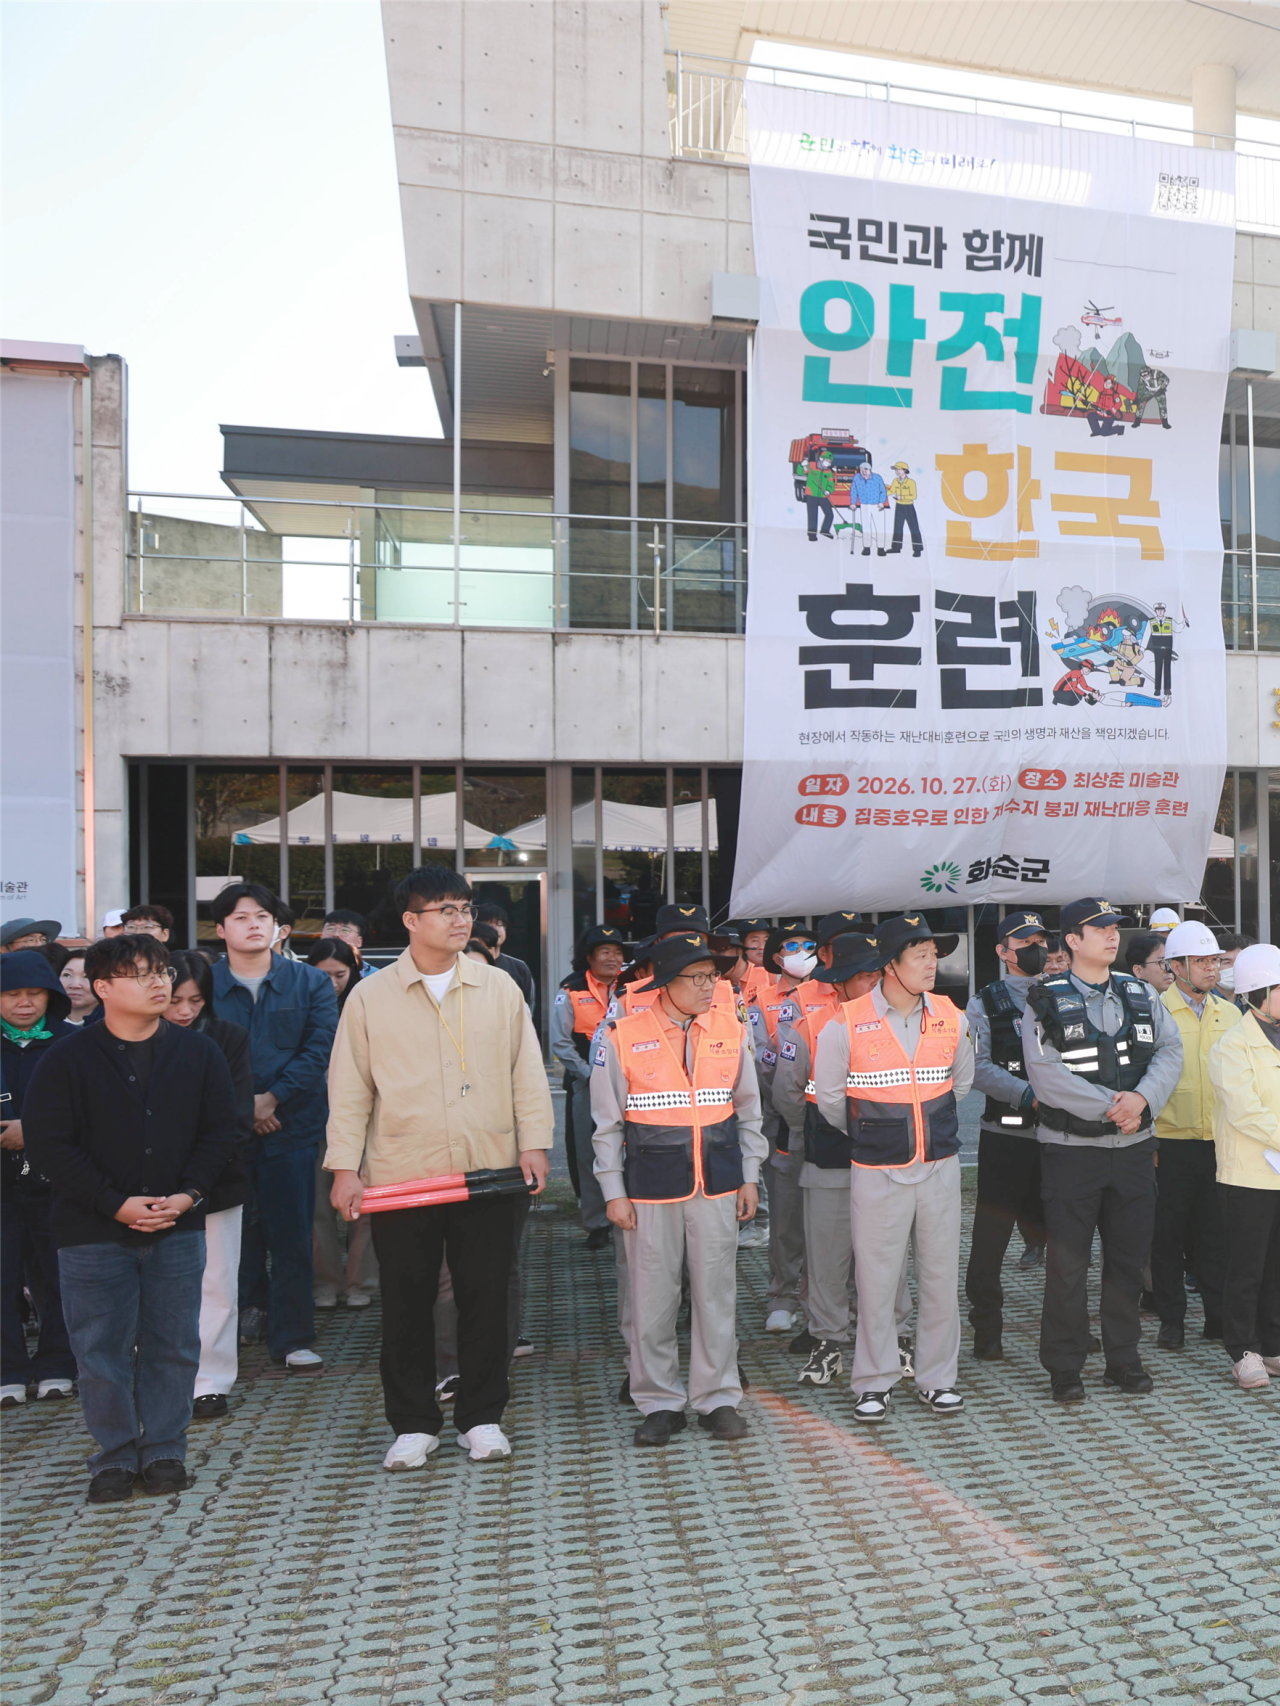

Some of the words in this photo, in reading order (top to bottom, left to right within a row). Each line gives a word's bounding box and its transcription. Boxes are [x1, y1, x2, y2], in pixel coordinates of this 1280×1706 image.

[808, 213, 947, 269] 국민과
[963, 229, 1043, 277] 함께
[800, 280, 1043, 415] 안전
[935, 444, 1165, 561] 한국
[798, 583, 1043, 709] 훈련
[799, 731, 846, 744] 현장에서
[850, 730, 895, 742] 작동하는
[900, 730, 989, 743] 재난대비훈련으로
[1024, 727, 1057, 741] 생명과
[1059, 727, 1091, 740] 재산을
[1095, 727, 1169, 741] 책임지겠습니다.
[857, 776, 915, 795] 2026.
[920, 776, 947, 795] 10.
[1073, 772, 1125, 788] 최상준
[1128, 771, 1180, 788] 미술관
[855, 807, 948, 826] 집중호우로
[954, 806, 989, 825] 인한
[1044, 801, 1080, 818] 붕괴
[1083, 800, 1151, 817] 재난대응
[1154, 798, 1189, 817] 훈련
[966, 854, 1050, 884] 화순군
